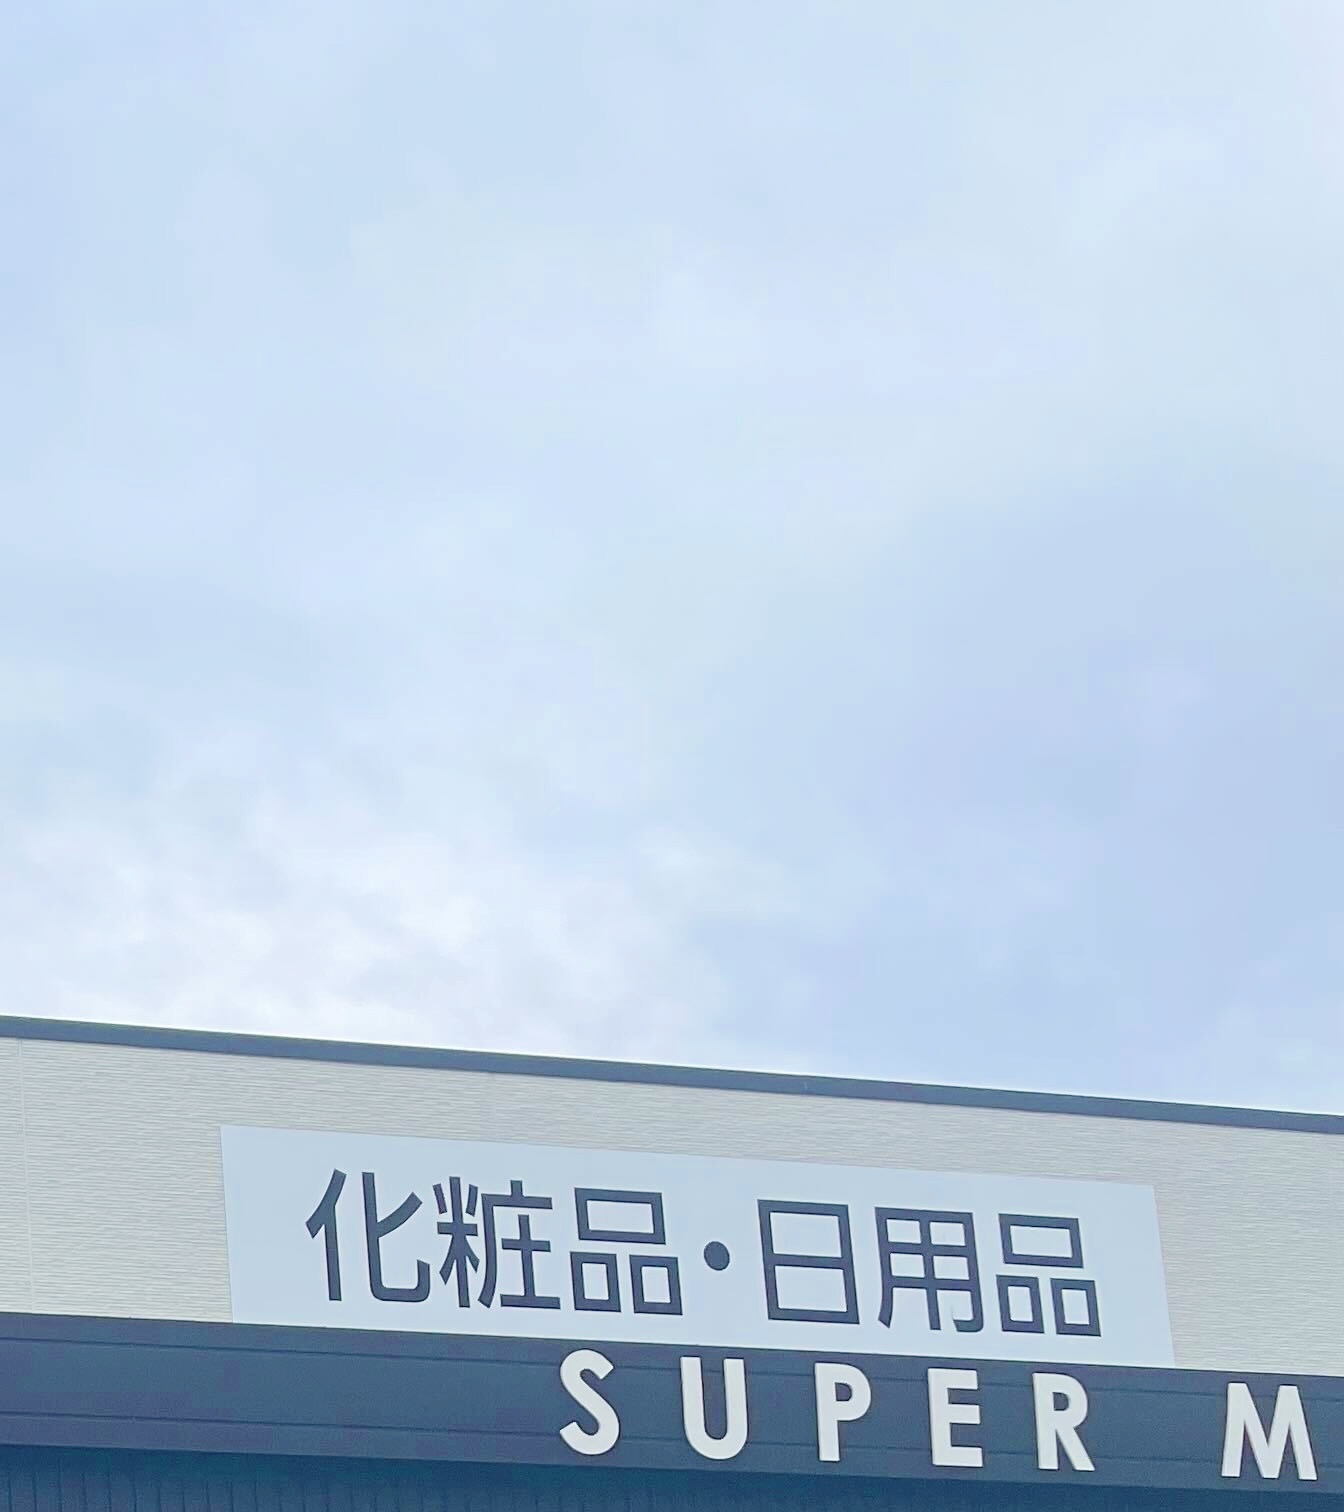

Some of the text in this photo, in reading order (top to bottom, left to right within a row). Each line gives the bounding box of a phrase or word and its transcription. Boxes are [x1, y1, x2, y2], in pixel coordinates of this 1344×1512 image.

[305, 1168, 1102, 1337] 化粧品・日用品
[558, 1348, 1319, 1481] SUPER M
